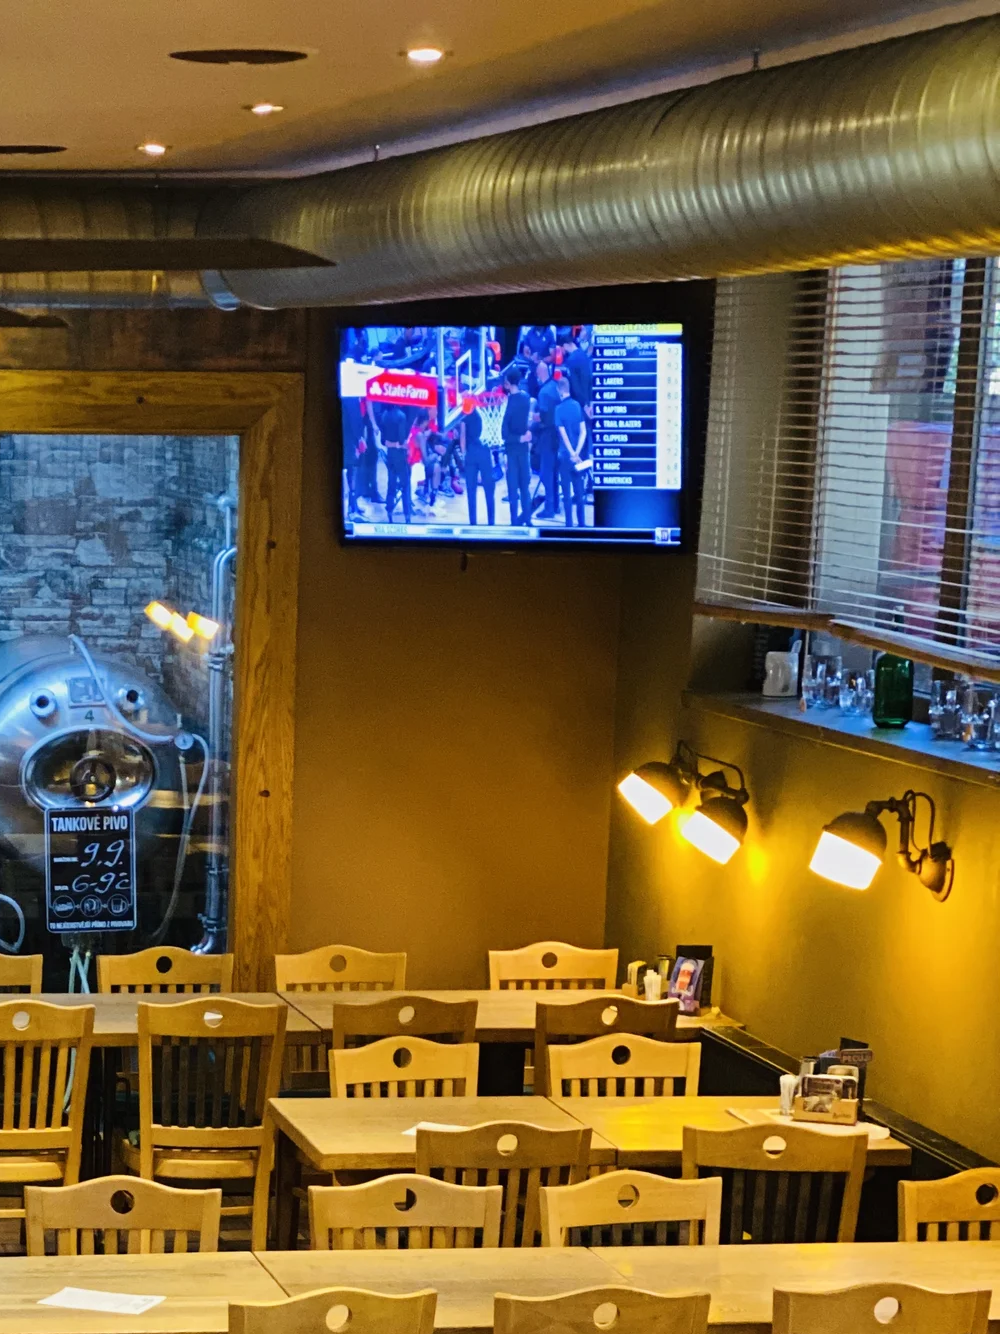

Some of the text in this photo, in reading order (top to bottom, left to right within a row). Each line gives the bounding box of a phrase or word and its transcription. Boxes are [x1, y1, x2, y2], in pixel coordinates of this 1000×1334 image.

[603, 363, 623, 371] PACERS
[603, 377, 624, 385] LAKERS
[603, 406, 627, 414] RAPTORS
[603, 420, 618, 428] TRAIL
[618, 420, 642, 428] BLAZERS
[603, 434, 628, 442] CLIPPERS
[84, 709, 95, 721] 4
[51, 814, 128, 832] TANKOVÉ PIVO
